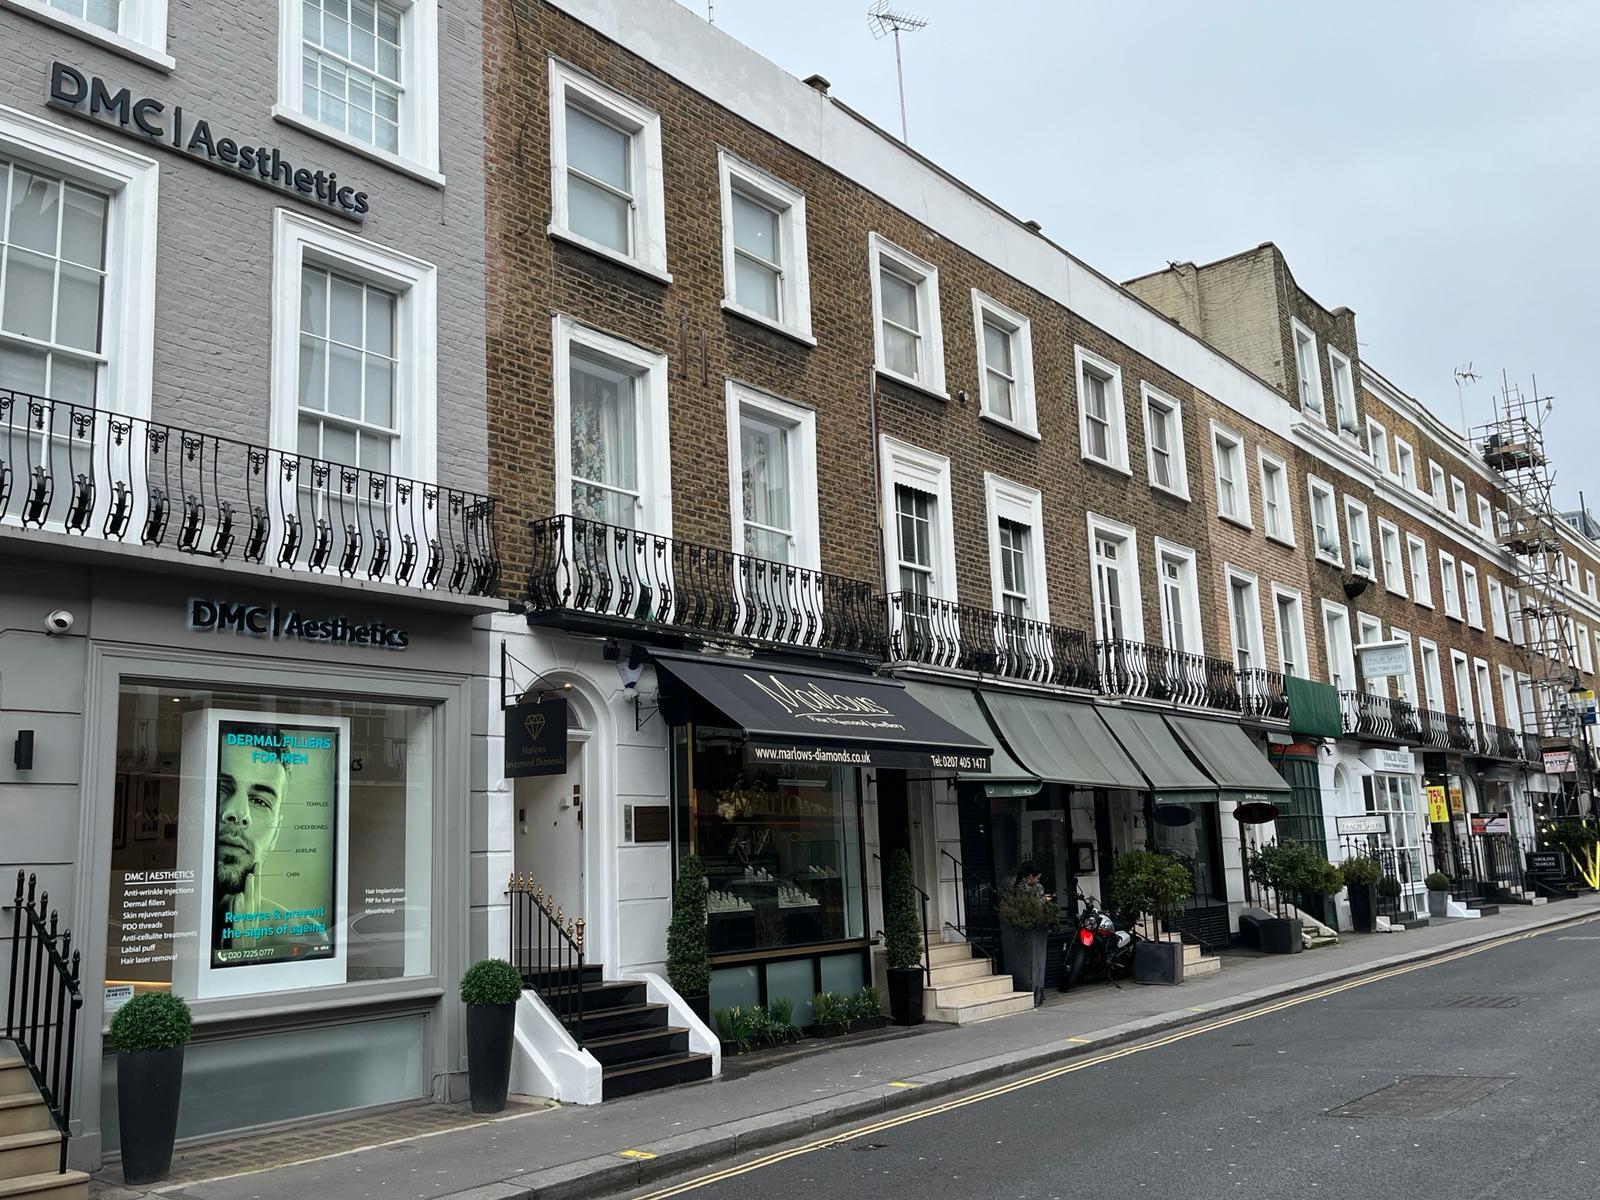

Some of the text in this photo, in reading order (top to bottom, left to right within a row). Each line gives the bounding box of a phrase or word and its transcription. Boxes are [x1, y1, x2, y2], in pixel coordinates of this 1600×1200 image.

[51, 61, 369, 214] DMC Aesthetics
[192, 600, 410, 648] DMC Aesthetics
[226, 733, 331, 749] DERMAL FILLERS
[252, 751, 308, 765] FOR MEN
[755, 747, 871, 763] www.marlows-diamonds.co.uk
[943, 756, 958, 767] 0207
[959, 757, 971, 768] 405
[972, 758, 986, 769] 1477
[124, 870, 194, 881] DMC AESTHETICS
[124, 887, 194, 896] Anti-wrinkle injections
[123, 899, 165, 908] Dermal fillers
[138, 910, 178, 919] rejuvenation
[225, 911, 270, 923] Reverse
[283, 906, 325, 922] prevent
[139, 921, 163, 929] threads
[122, 930, 198, 942] Anti-cellulite treatments
[223, 924, 326, 939] the signs of ageing
[121, 944, 156, 953] Labial puff
[228, 951, 241, 959] 020
[243, 949, 258, 957] 7225
[121, 953, 178, 965] Hair laser removal
